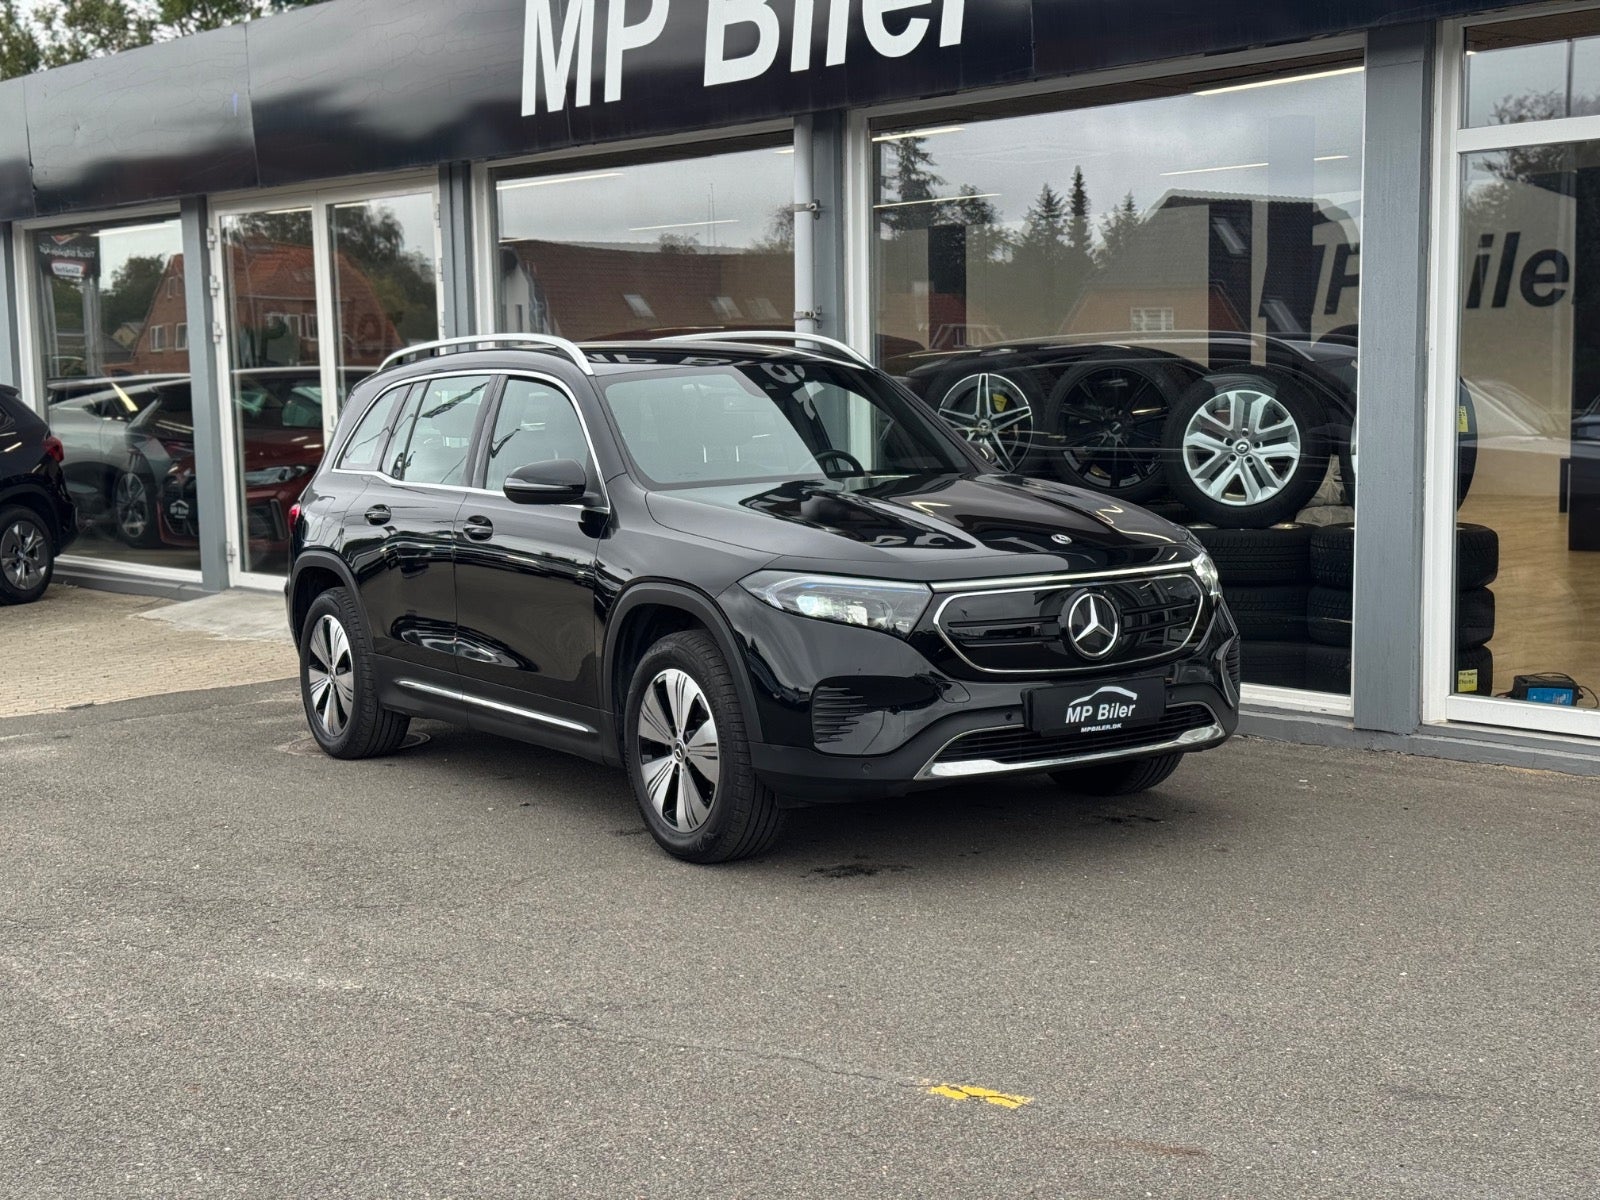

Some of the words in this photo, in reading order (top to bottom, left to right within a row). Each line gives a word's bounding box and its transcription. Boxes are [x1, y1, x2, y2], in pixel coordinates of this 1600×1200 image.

[521, 0, 669, 116] MP
[1466, 231, 1575, 309] ile
[1065, 705, 1093, 723] MP
[1097, 702, 1136, 721] Biler
